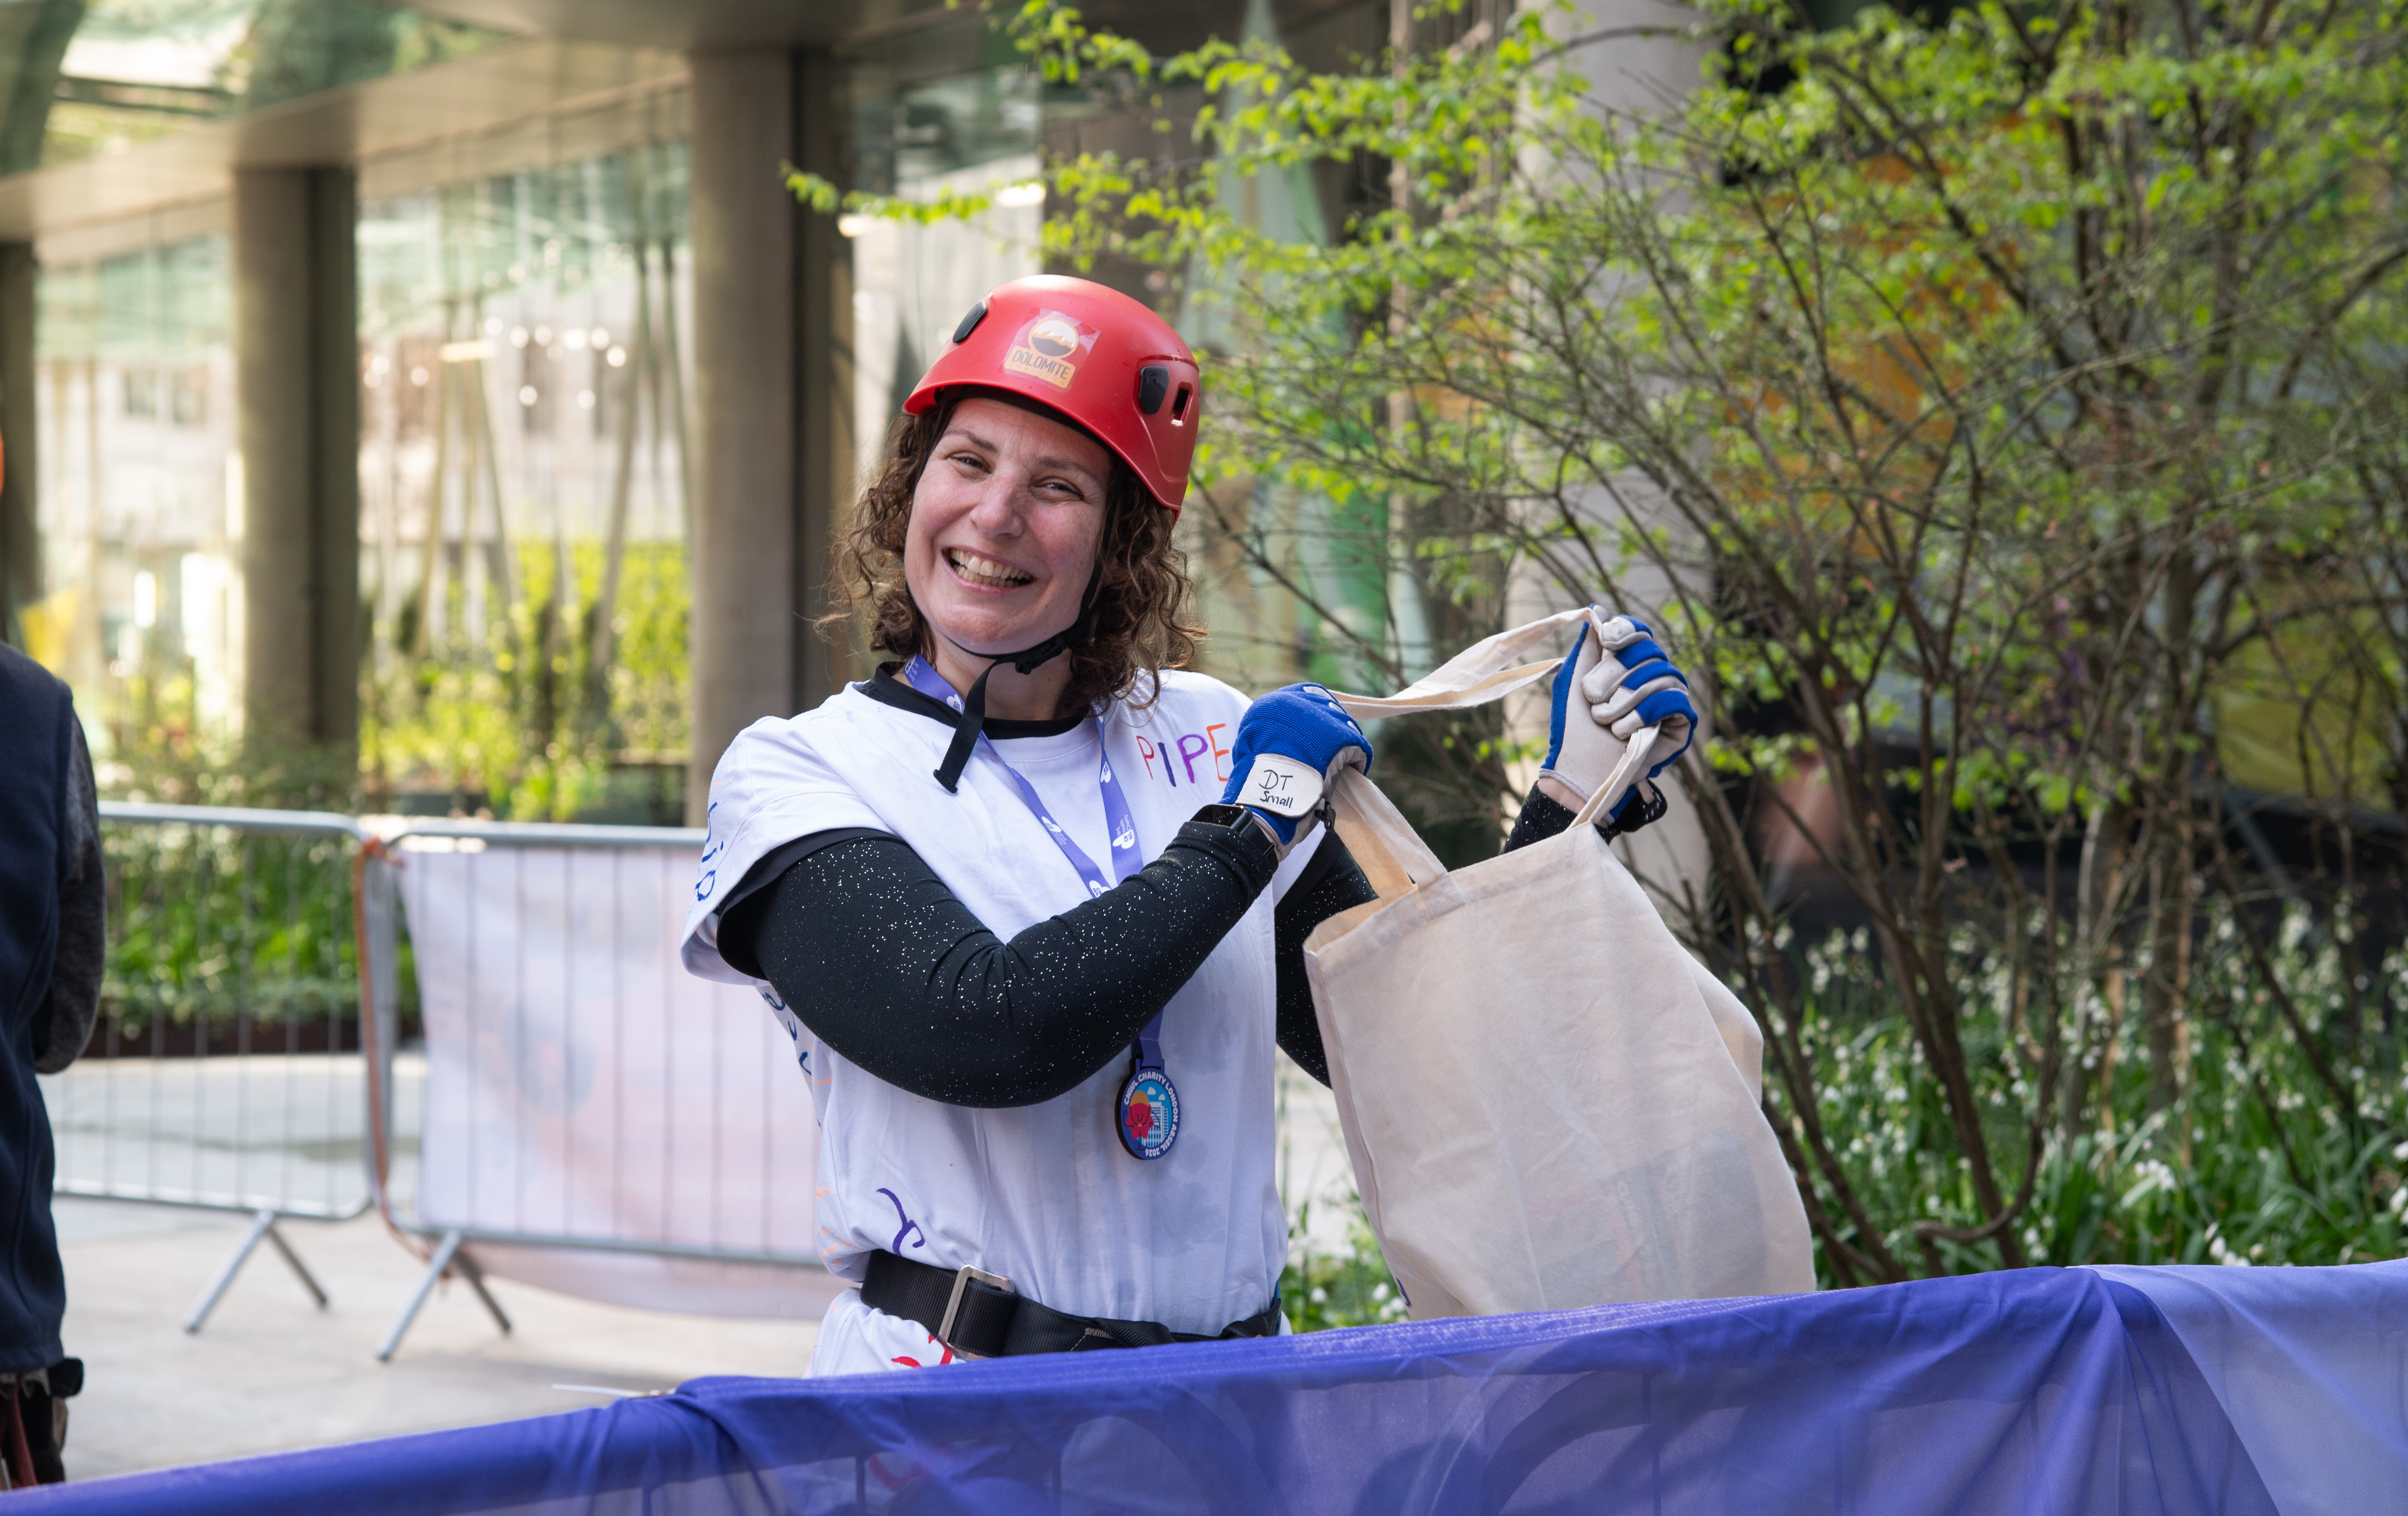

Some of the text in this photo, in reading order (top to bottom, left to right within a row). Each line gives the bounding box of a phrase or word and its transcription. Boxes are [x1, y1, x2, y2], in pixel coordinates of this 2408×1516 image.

[1012, 350, 1071, 380] DOLOMITE
[1136, 723, 1229, 787] PIPE
[1259, 769, 1293, 790] DT
[1260, 790, 1293, 808] Small
[1128, 831, 1133, 840] WL
[1093, 888, 1099, 896] WL
[1138, 1071, 1166, 1084] CHARITY
[1124, 1080, 1138, 1105] CNWL
[1165, 1082, 1178, 1122] LONDON
[1160, 1123, 1177, 1151] ABSEIL
